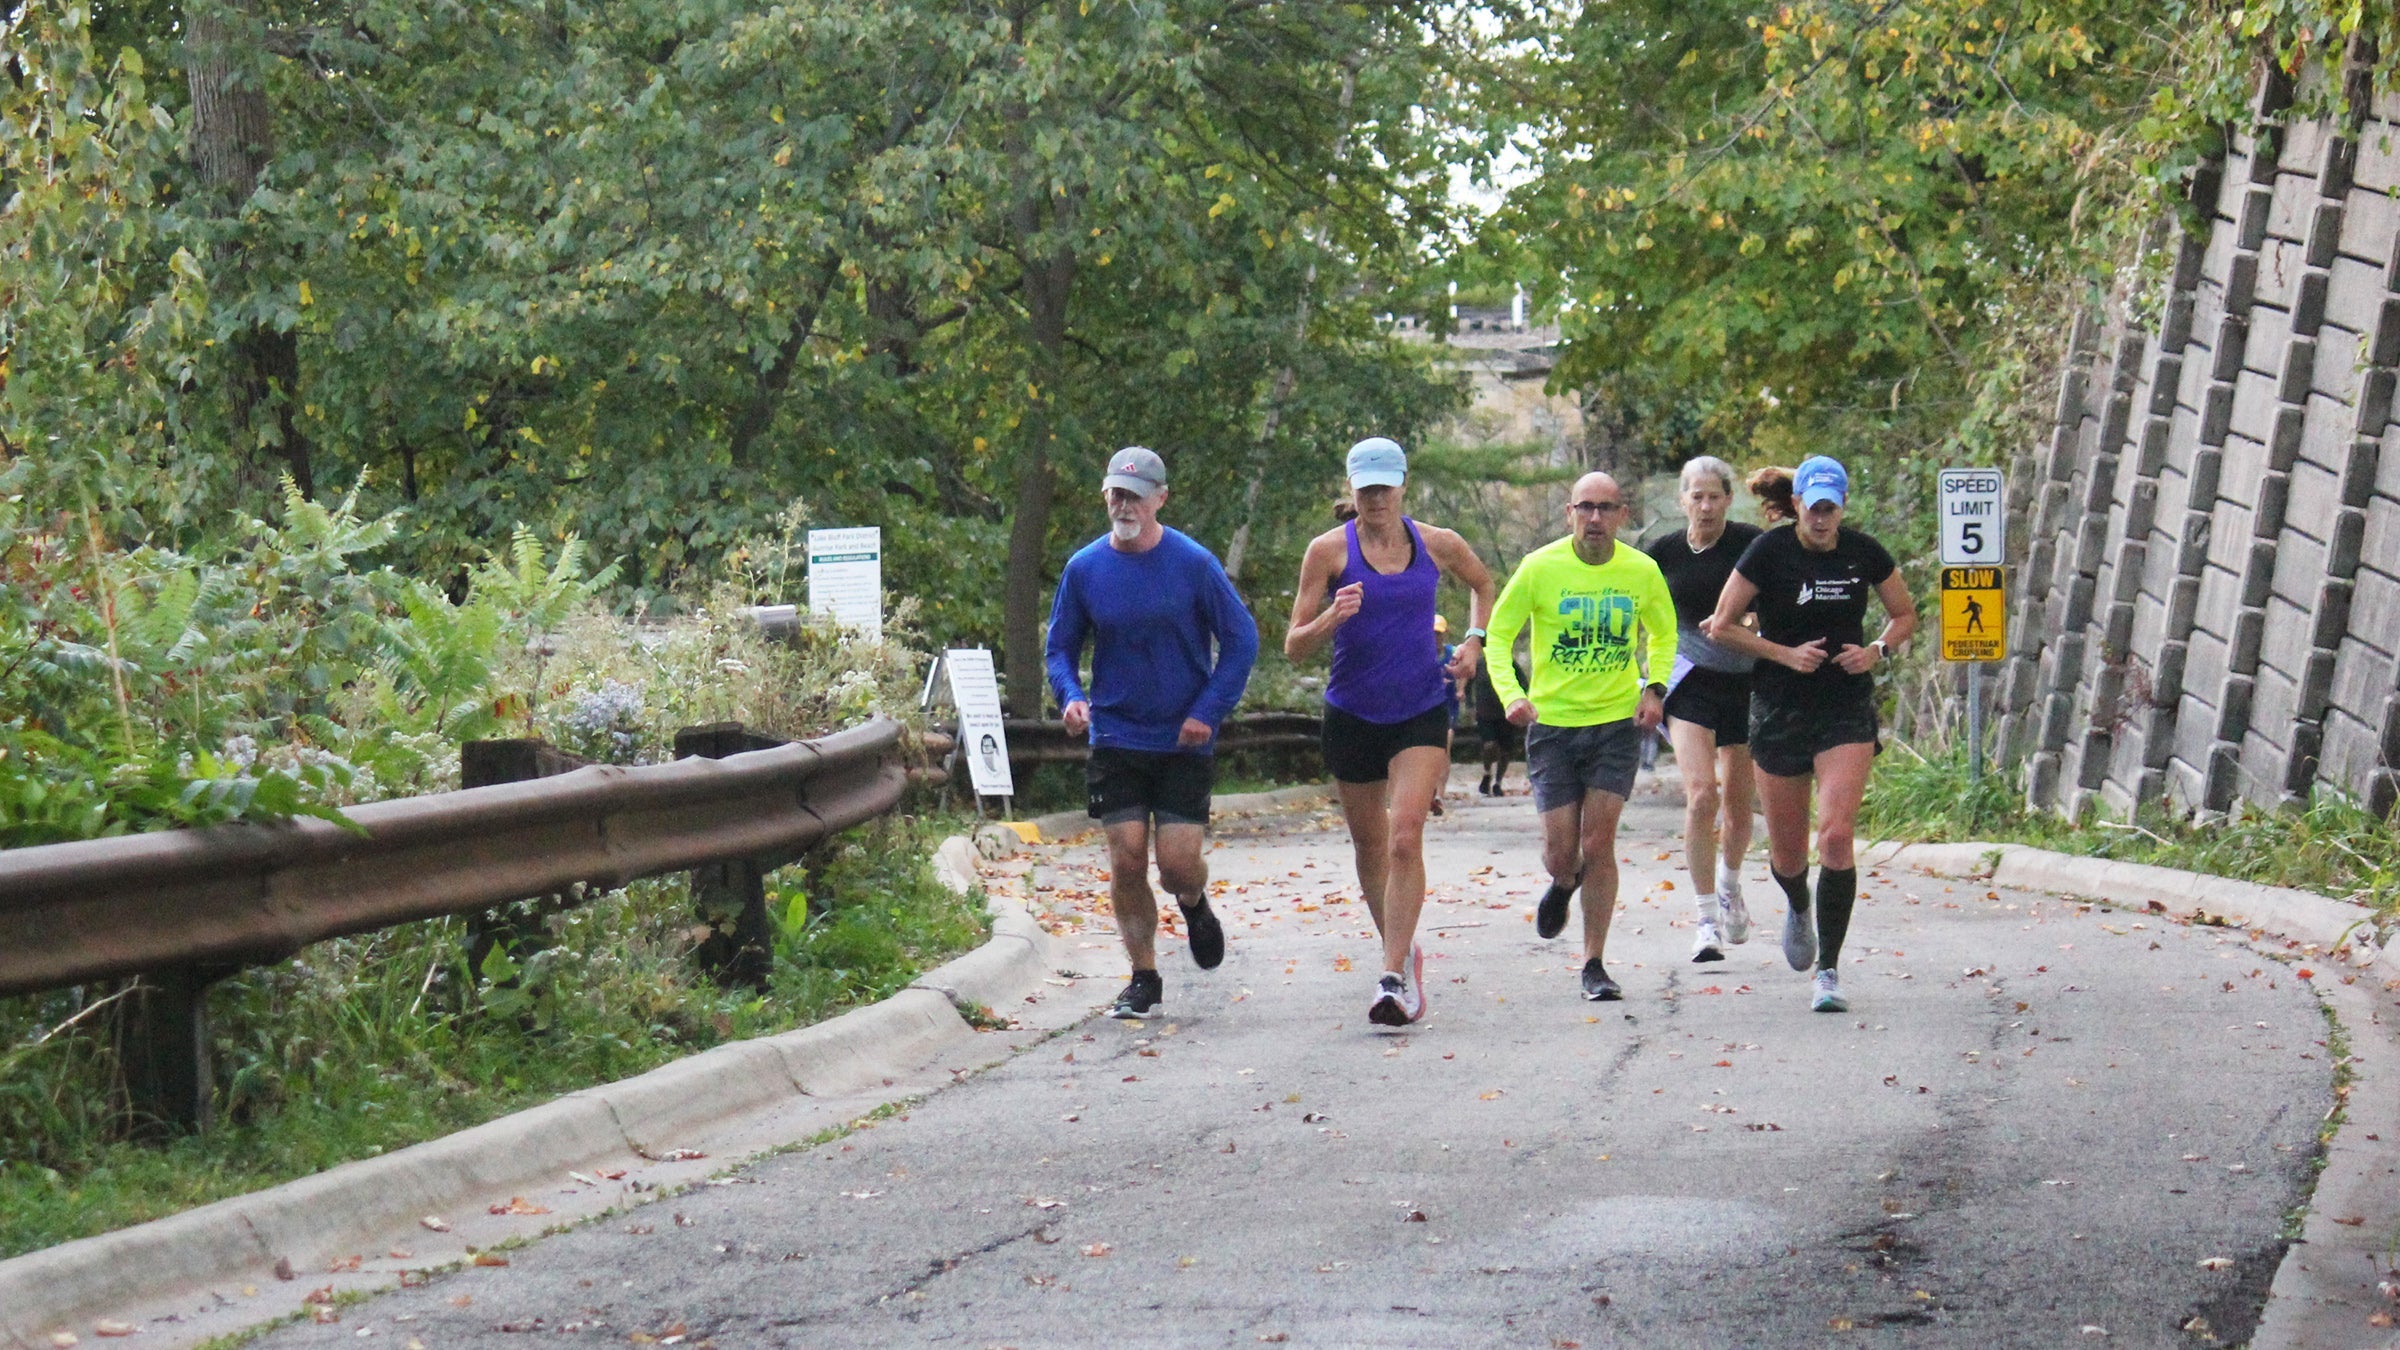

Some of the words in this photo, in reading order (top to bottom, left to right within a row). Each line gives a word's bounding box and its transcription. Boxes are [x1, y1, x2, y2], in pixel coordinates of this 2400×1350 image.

[1945, 479, 1998, 493] SPEED
[1951, 501, 1994, 515] LIMIT
[1961, 522, 1984, 554] 5
[1949, 569, 1995, 588] SLOW
[1815, 586, 1844, 595] Chicago
[1558, 596, 1633, 648] 30
[1947, 639, 1999, 648] PEDESTRIAN
[1590, 647, 1632, 671] Relay
